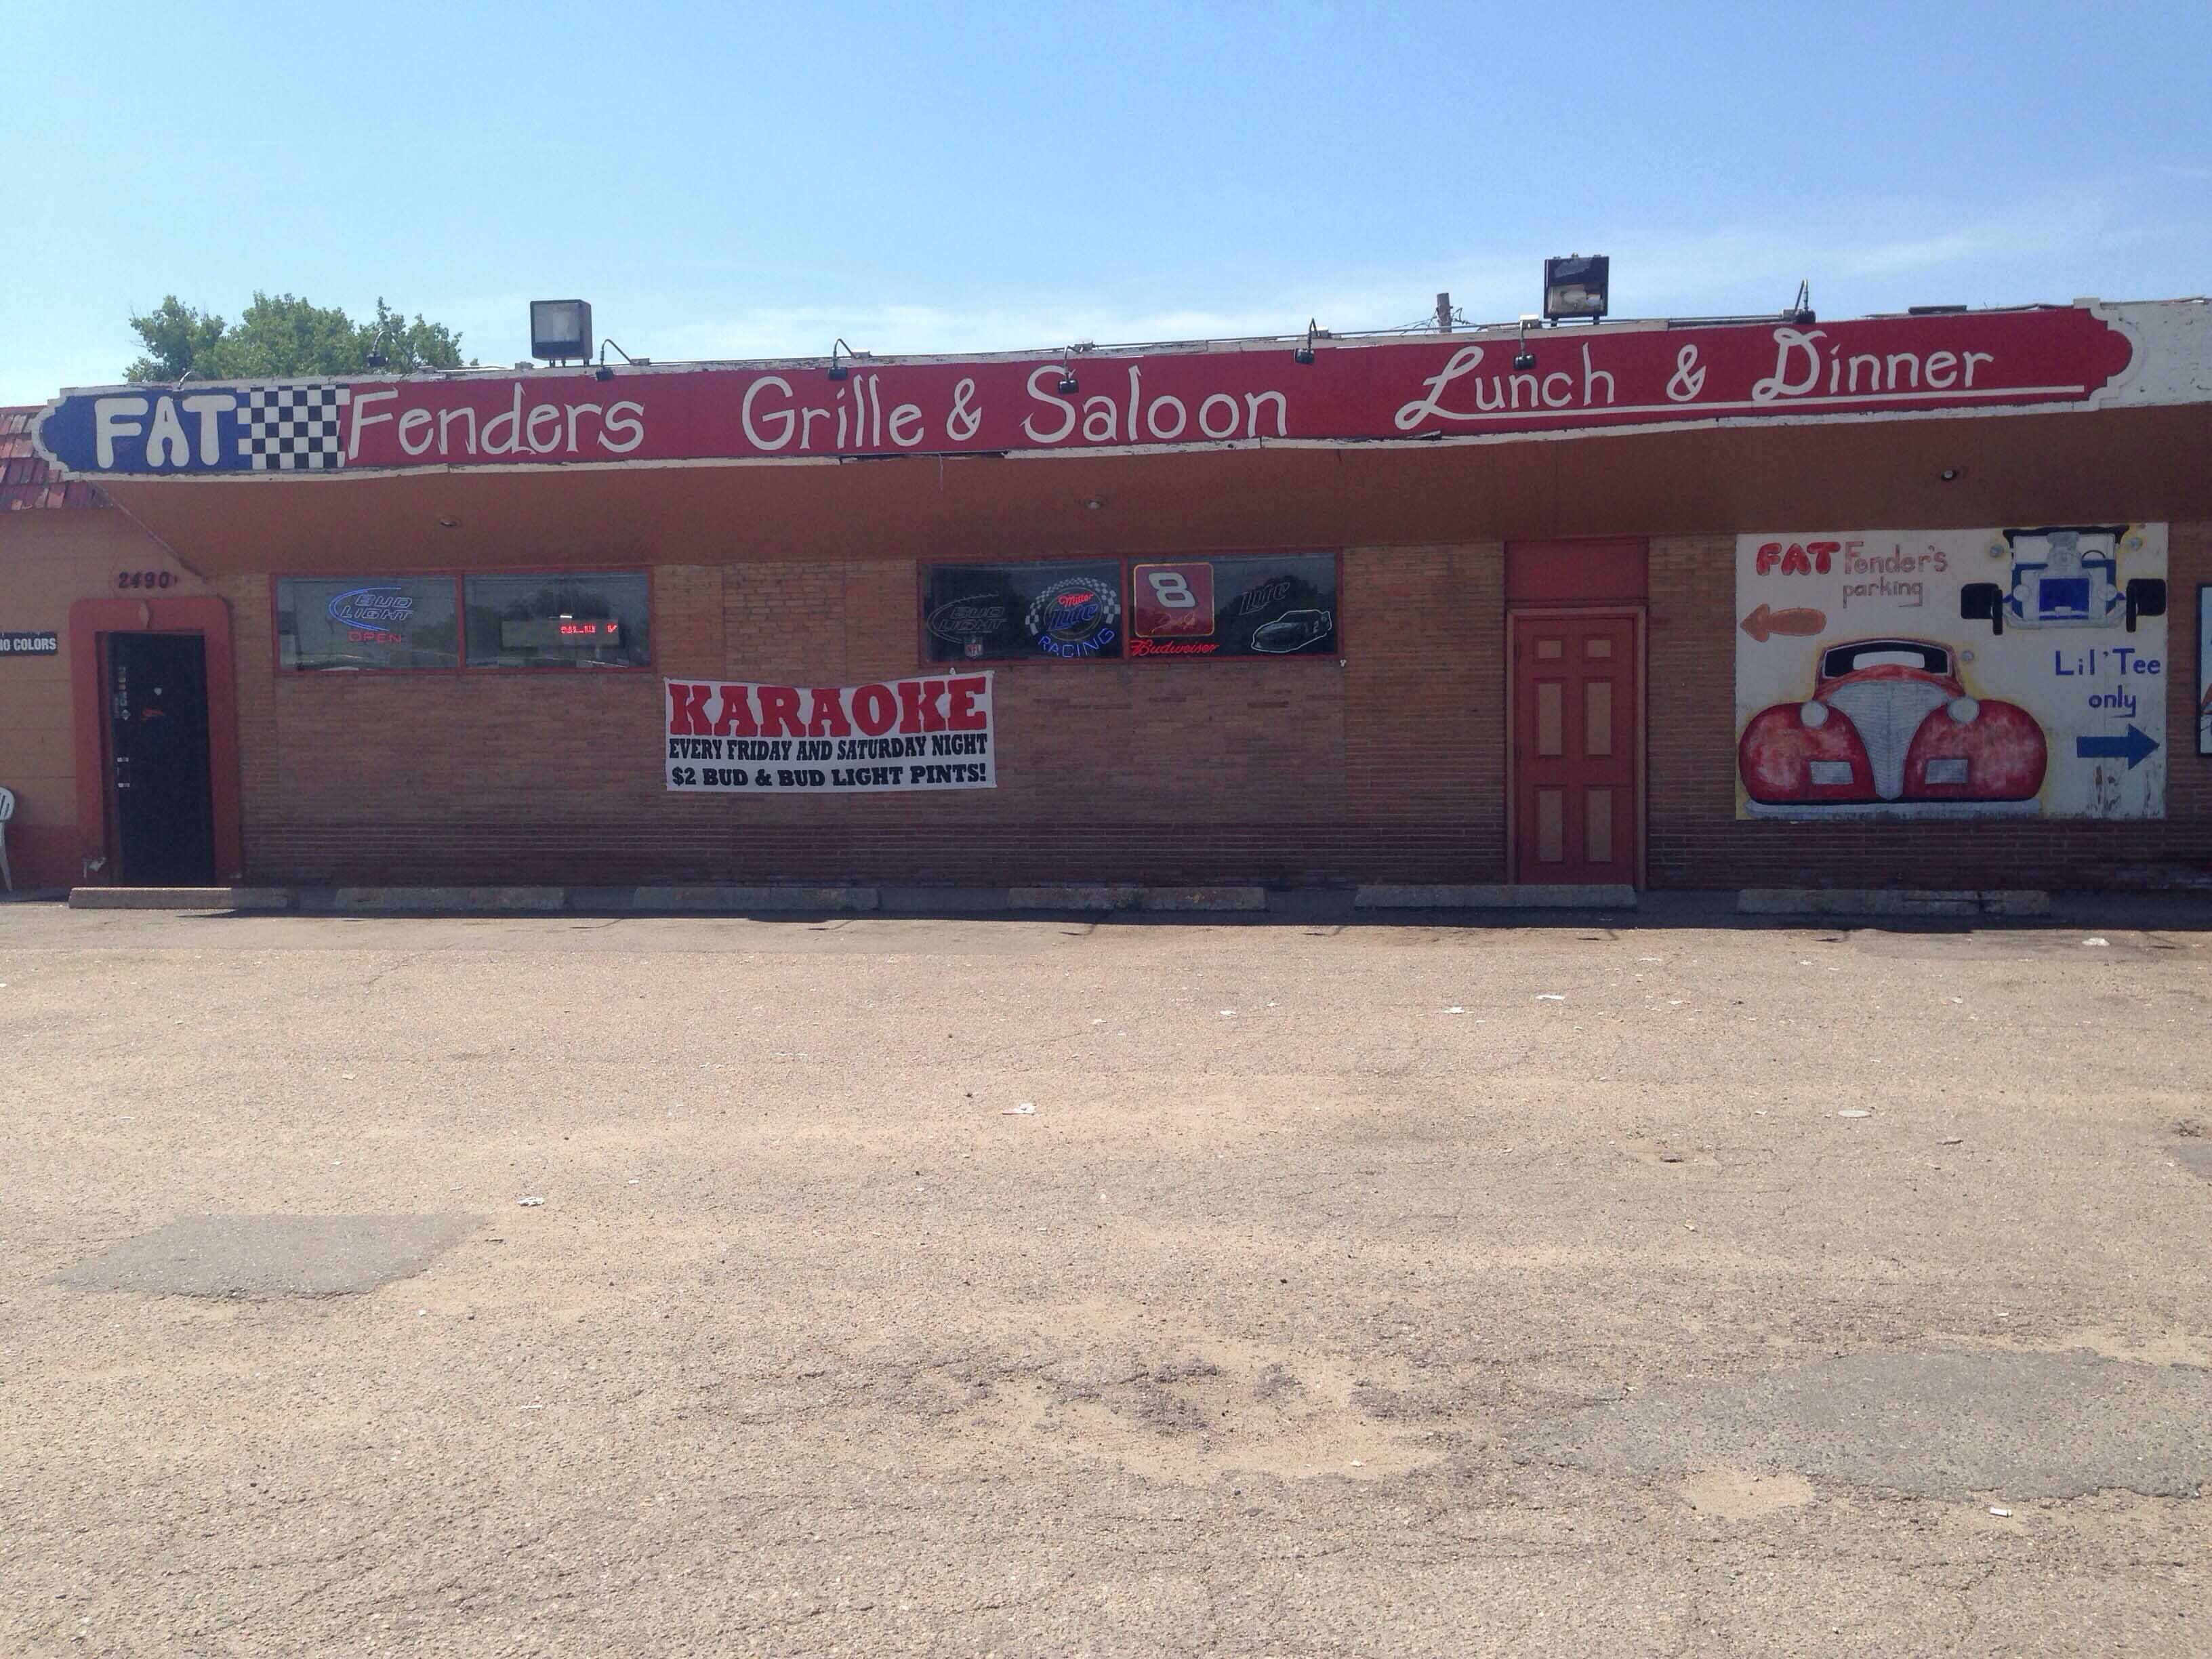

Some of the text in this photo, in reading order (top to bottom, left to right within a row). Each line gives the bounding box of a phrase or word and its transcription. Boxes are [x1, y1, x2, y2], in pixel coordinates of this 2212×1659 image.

[94, 327, 1994, 468] FAT Fenders Grille & Saloon Lunch & Dinner
[1756, 541, 1948, 575] FAT Fender's
[119, 571, 169, 588] 2490
[1148, 572, 1195, 607] 8
[1843, 577, 1923, 609] parking
[340, 605, 414, 621] LIGHT
[355, 594, 413, 608] BUD
[14, 638, 56, 651] COLORS
[348, 630, 402, 644] OPEN
[1038, 628, 1115, 657] RACING
[1130, 639, 1219, 656] Budweiser
[2112, 648, 2160, 676] Tee
[669, 677, 987, 737] KARAOKE
[2088, 684, 2136, 718] only
[669, 733, 987, 761] EVERY FRIDAY AND SATURDAY NIGHT
[672, 762, 987, 787] $2 BUD & BUD LIGHT PINTS!
